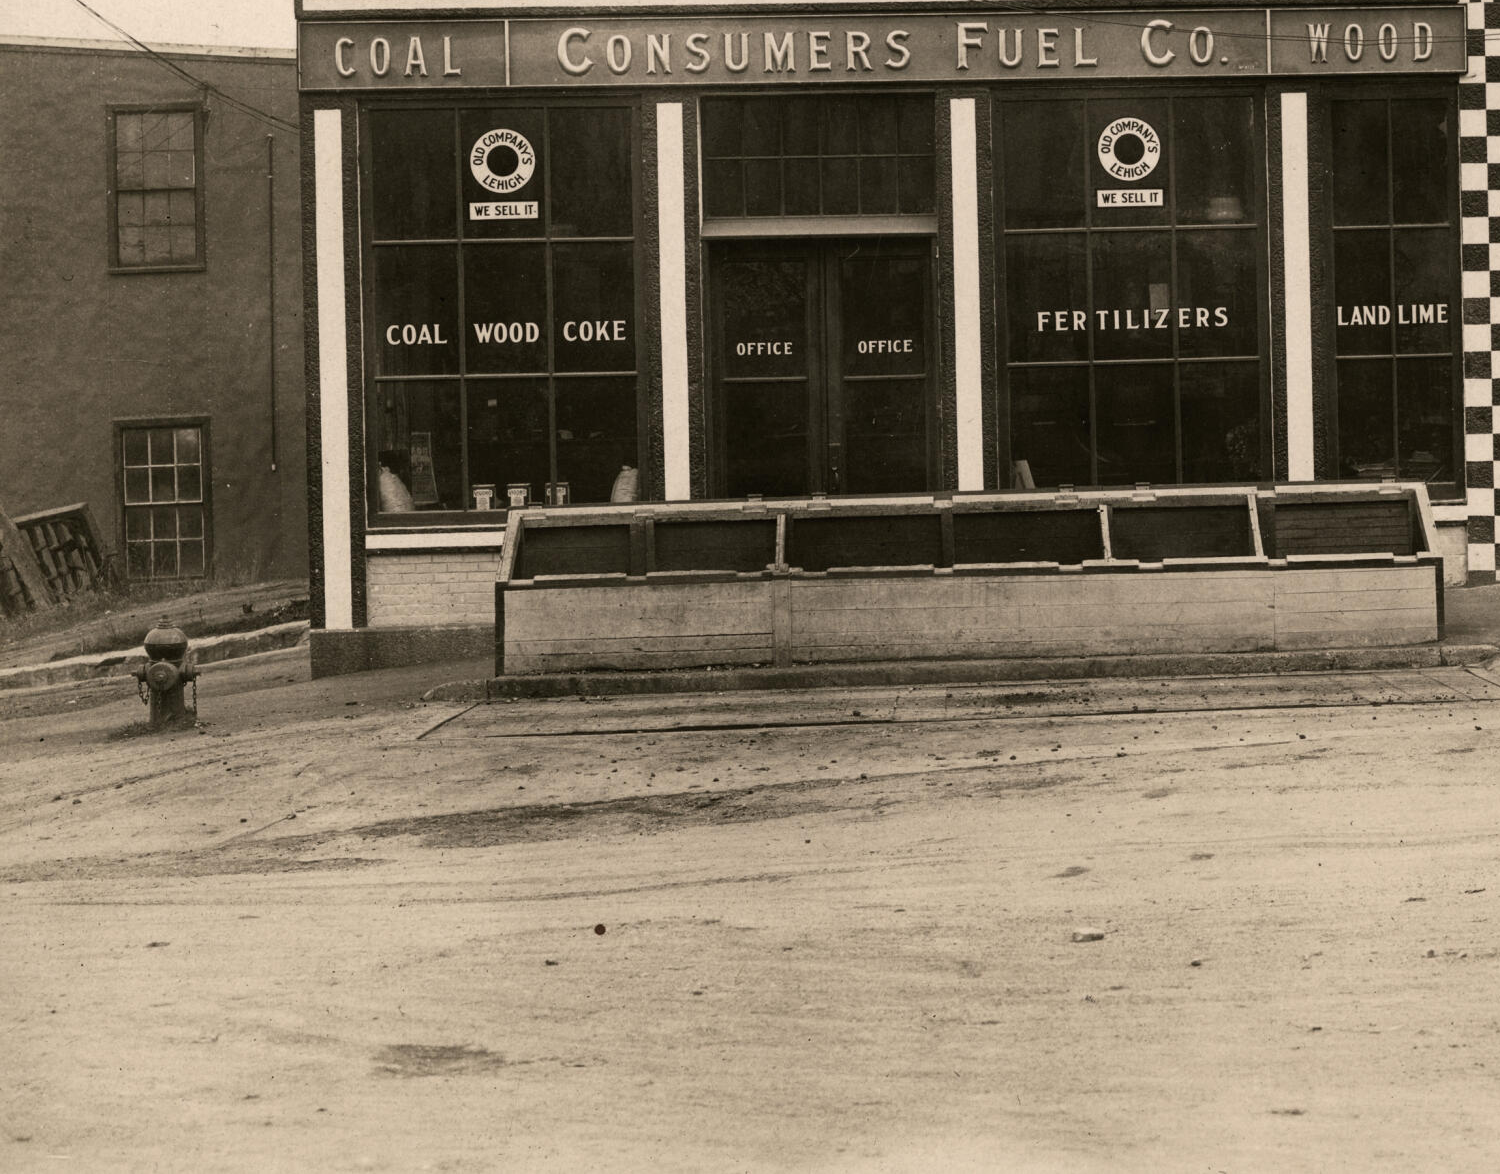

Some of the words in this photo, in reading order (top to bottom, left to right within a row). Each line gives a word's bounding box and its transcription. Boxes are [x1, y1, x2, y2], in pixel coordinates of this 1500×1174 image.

[556, 27, 912, 77] CONSUMERS
[956, 21, 1098, 70] FUEL
[1141, 19, 1229, 68] CO.
[1307, 22, 1434, 64] WOOD
[334, 36, 462, 78] COAL
[1101, 135, 1113, 154] OLD
[473, 147, 486, 166] OLD
[1109, 161, 1151, 178] LEHIGH
[482, 173, 525, 190] LEHIGH
[1101, 193, 1117, 204] WE
[1121, 192, 1146, 203] SELL
[1149, 192, 1159, 203] IT
[474, 205, 491, 217] WE
[494, 204, 520, 216] SELL
[1037, 307, 1229, 332] FERTILIZERS
[1337, 305, 1391, 326] LAND
[1397, 303, 1449, 324] LIME
[386, 323, 448, 345] COAL
[473, 322, 540, 343] WOOD
[563, 320, 627, 342] COKE
[736, 341, 793, 356] OFFICE
[857, 339, 913, 354] OFFICE
